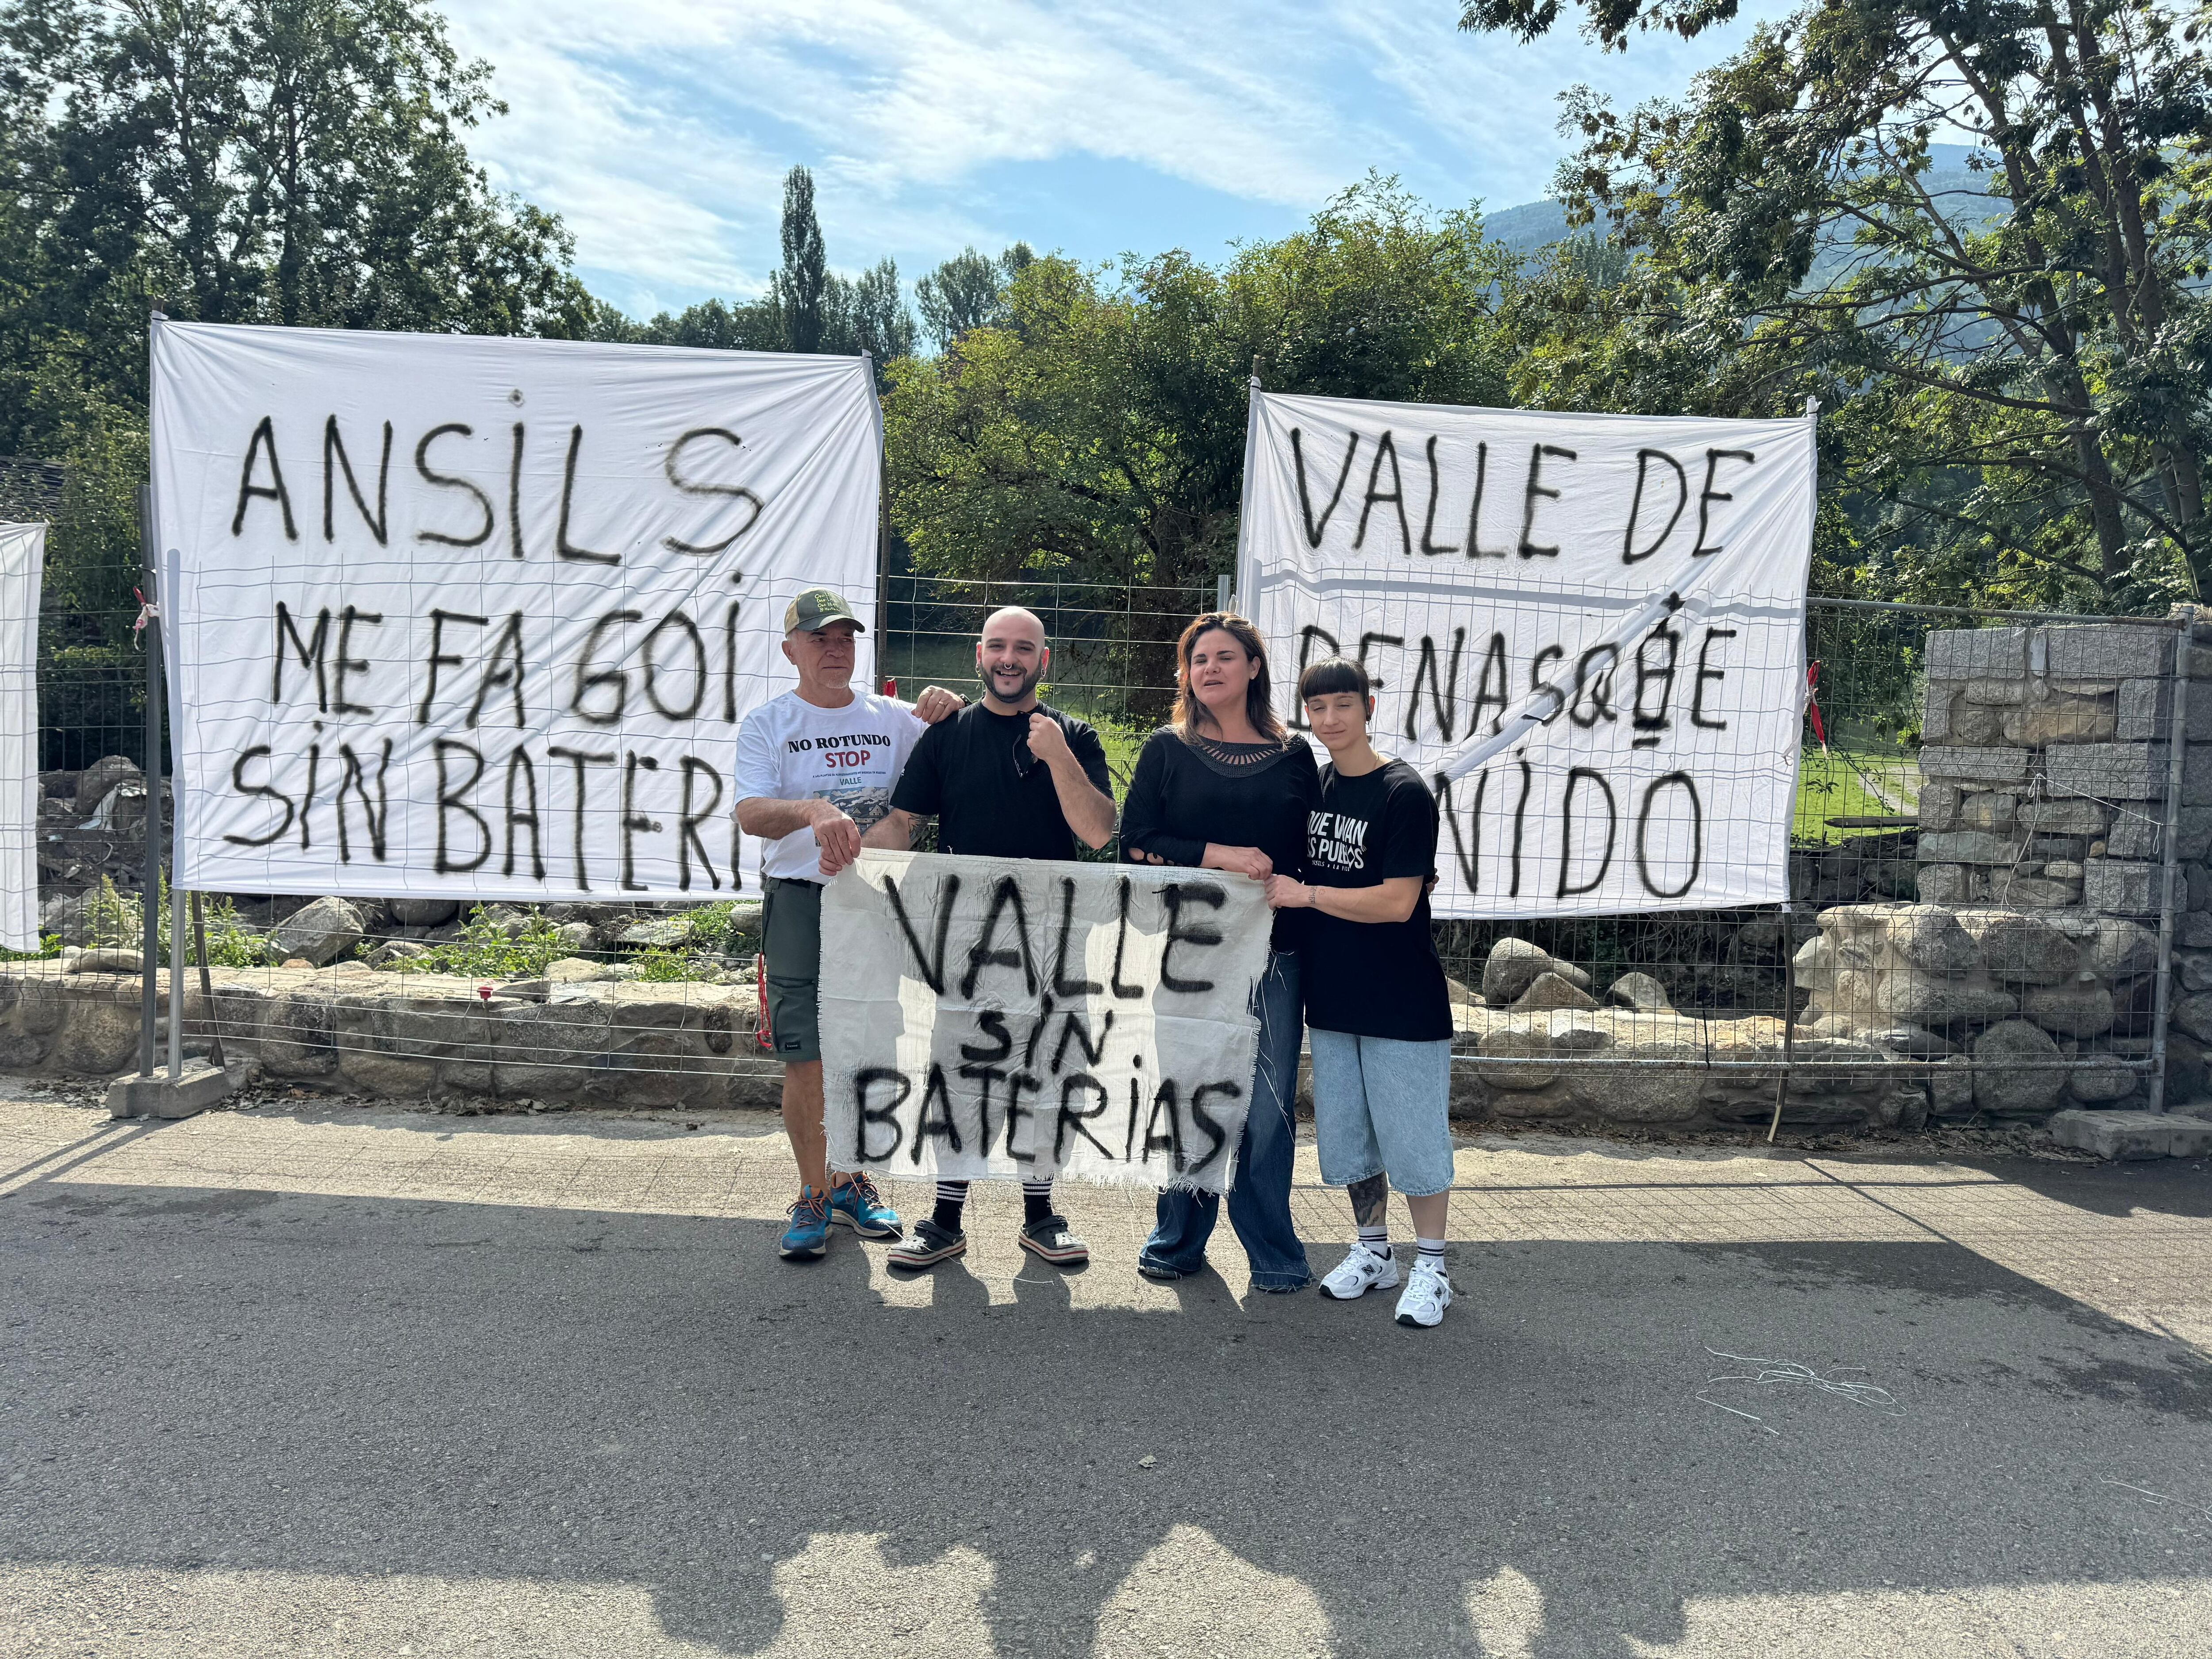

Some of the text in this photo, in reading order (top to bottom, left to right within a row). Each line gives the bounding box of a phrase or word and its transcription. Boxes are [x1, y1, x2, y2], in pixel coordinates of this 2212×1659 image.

[1290, 428, 1755, 565] VALLE DE
[273, 600, 383, 714] ME
[416, 608, 528, 729] FA
[788, 734, 891, 753] NO ROTUNDO
[825, 750, 871, 768] STOP
[840, 777, 862, 786] VALLE
[222, 721, 766, 892] SIN BATERI
[1435, 747, 1701, 899] NIDO
[882, 874, 1228, 1000] VALLE
[960, 992, 1113, 1073] SIN
[854, 1054, 1240, 1173] BATERIAS
[1361, 1264, 1376, 1278] N
